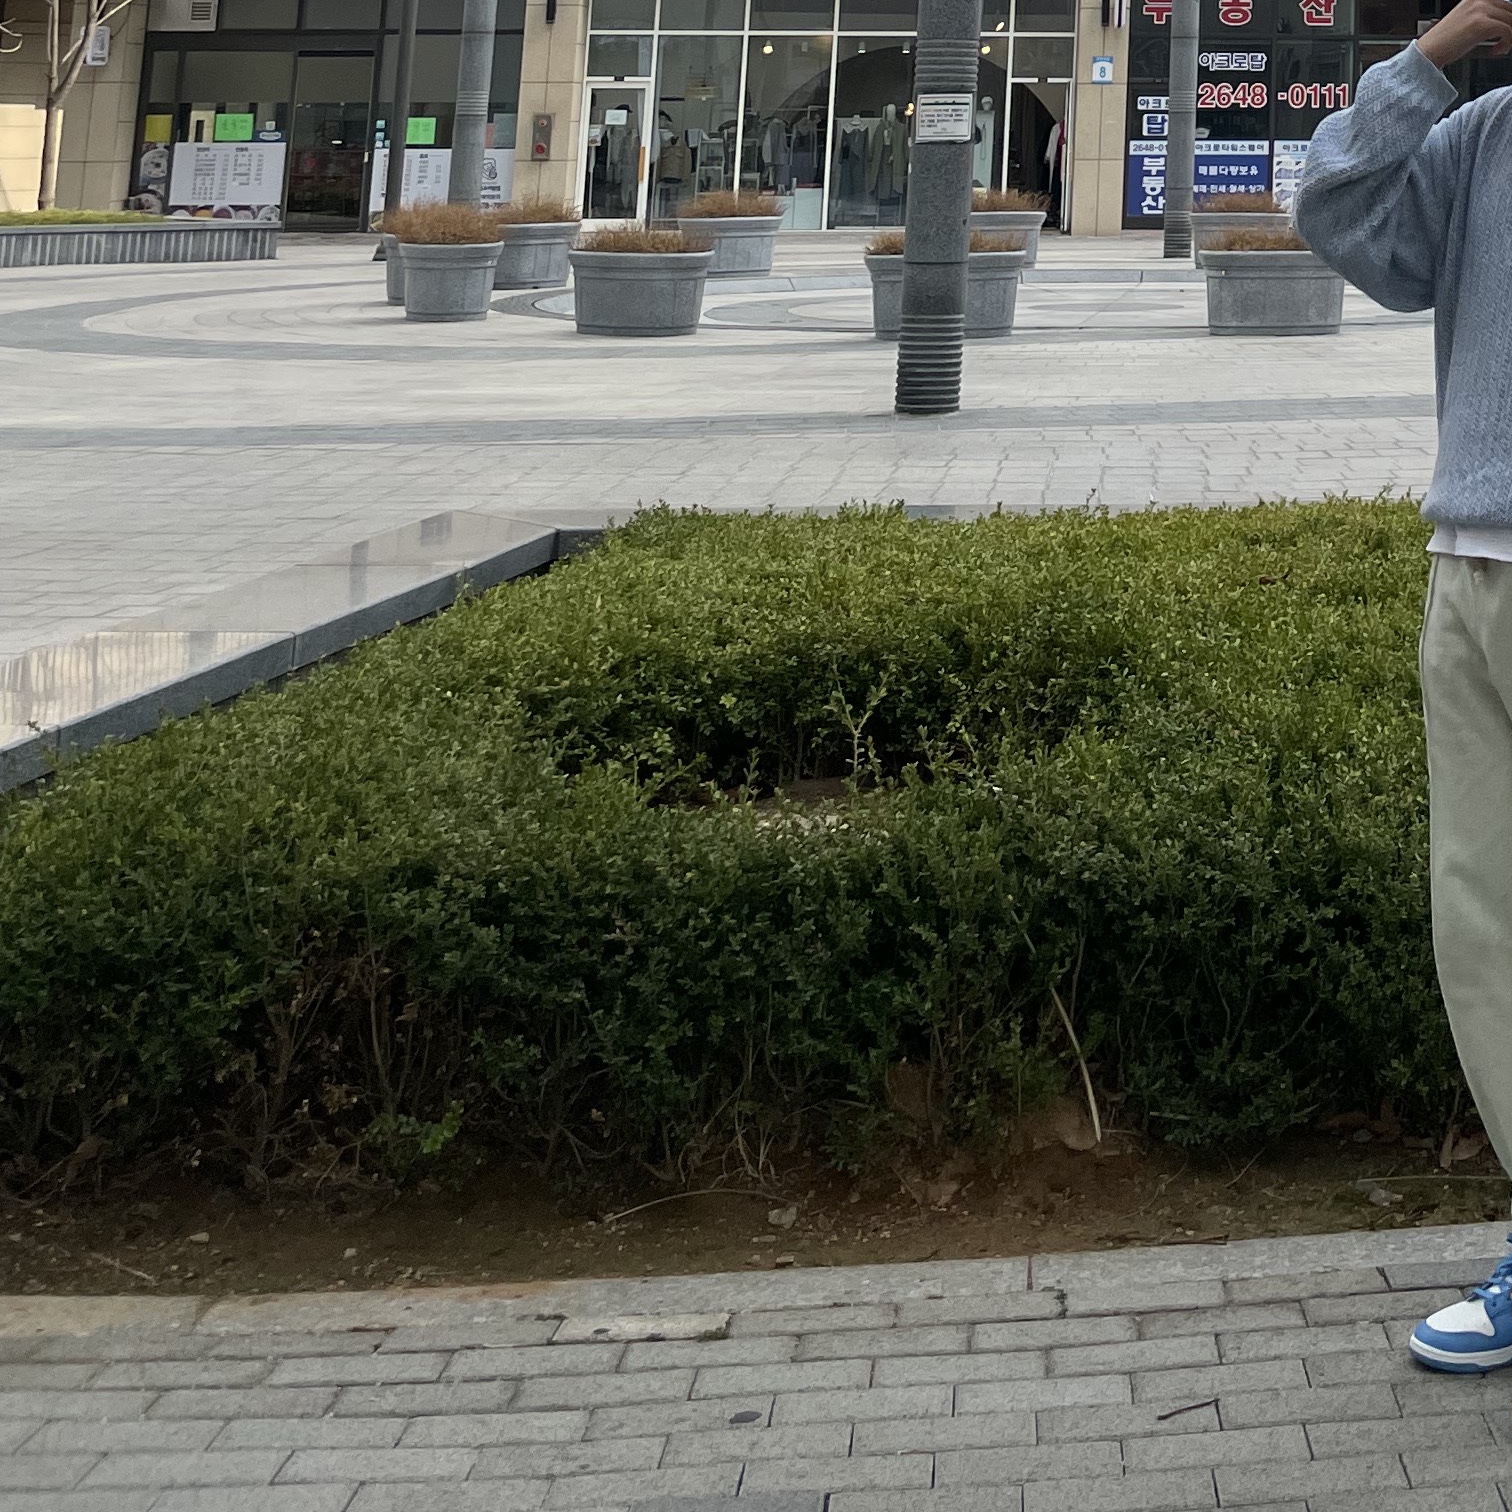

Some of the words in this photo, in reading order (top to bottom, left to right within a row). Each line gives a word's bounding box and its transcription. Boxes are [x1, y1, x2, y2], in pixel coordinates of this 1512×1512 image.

[1199, 52, 1267, 72] 아크로탑
[1099, 66, 1106, 79] 8
[1141, 157, 1167, 215] 부동산
